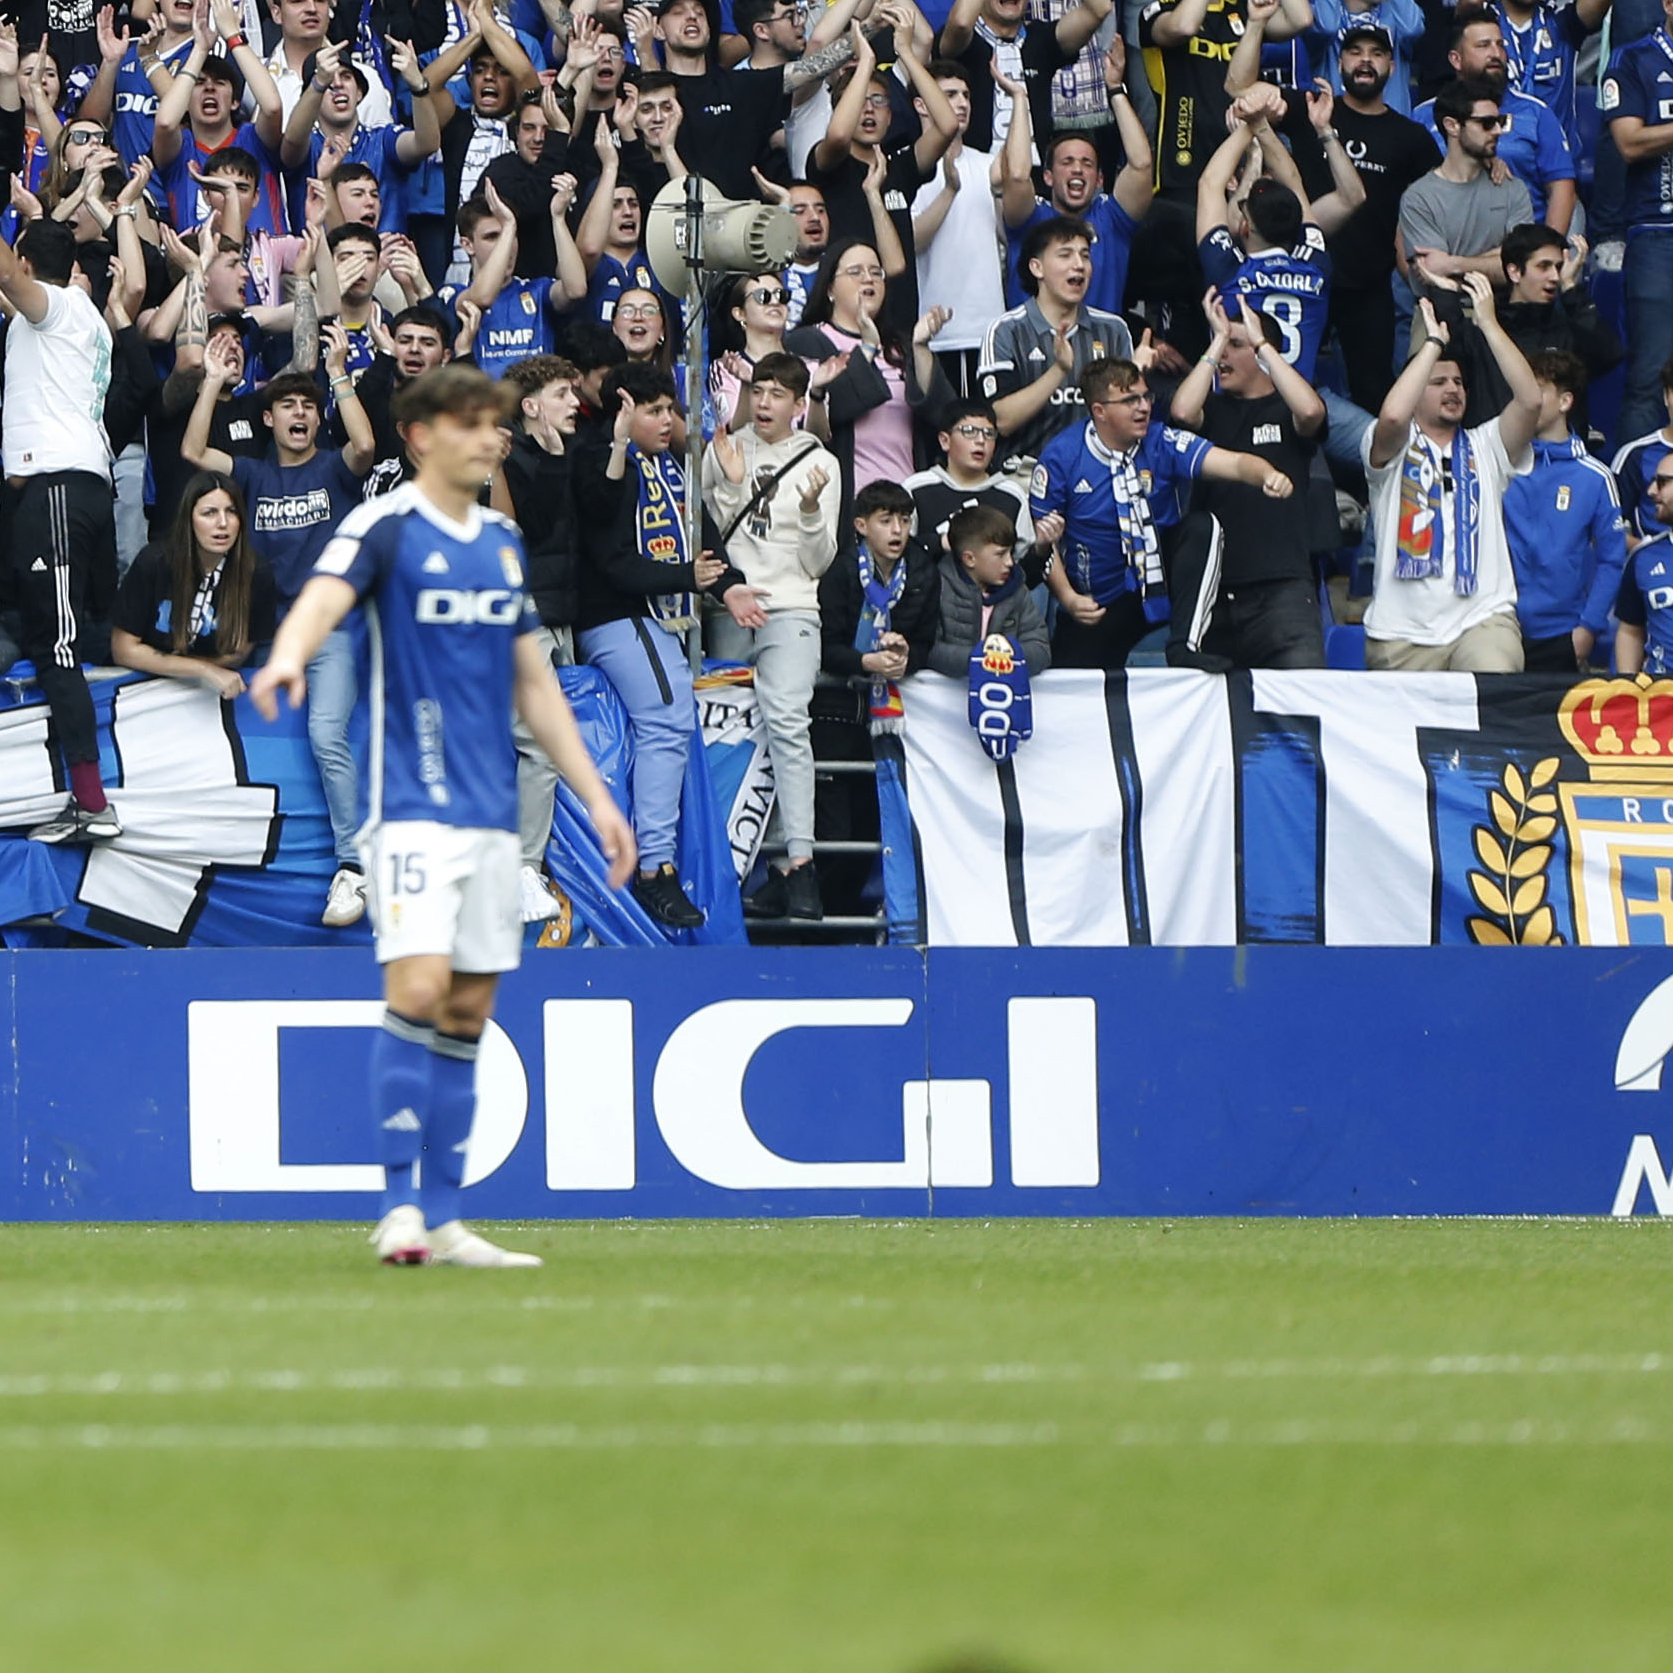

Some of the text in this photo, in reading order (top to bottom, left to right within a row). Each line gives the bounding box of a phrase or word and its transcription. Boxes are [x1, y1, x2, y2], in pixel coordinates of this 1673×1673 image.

[1175, 96, 1188, 150] OVIEDO
[388, 853, 425, 896] 15
[187, 995, 1101, 1193] DIGI
